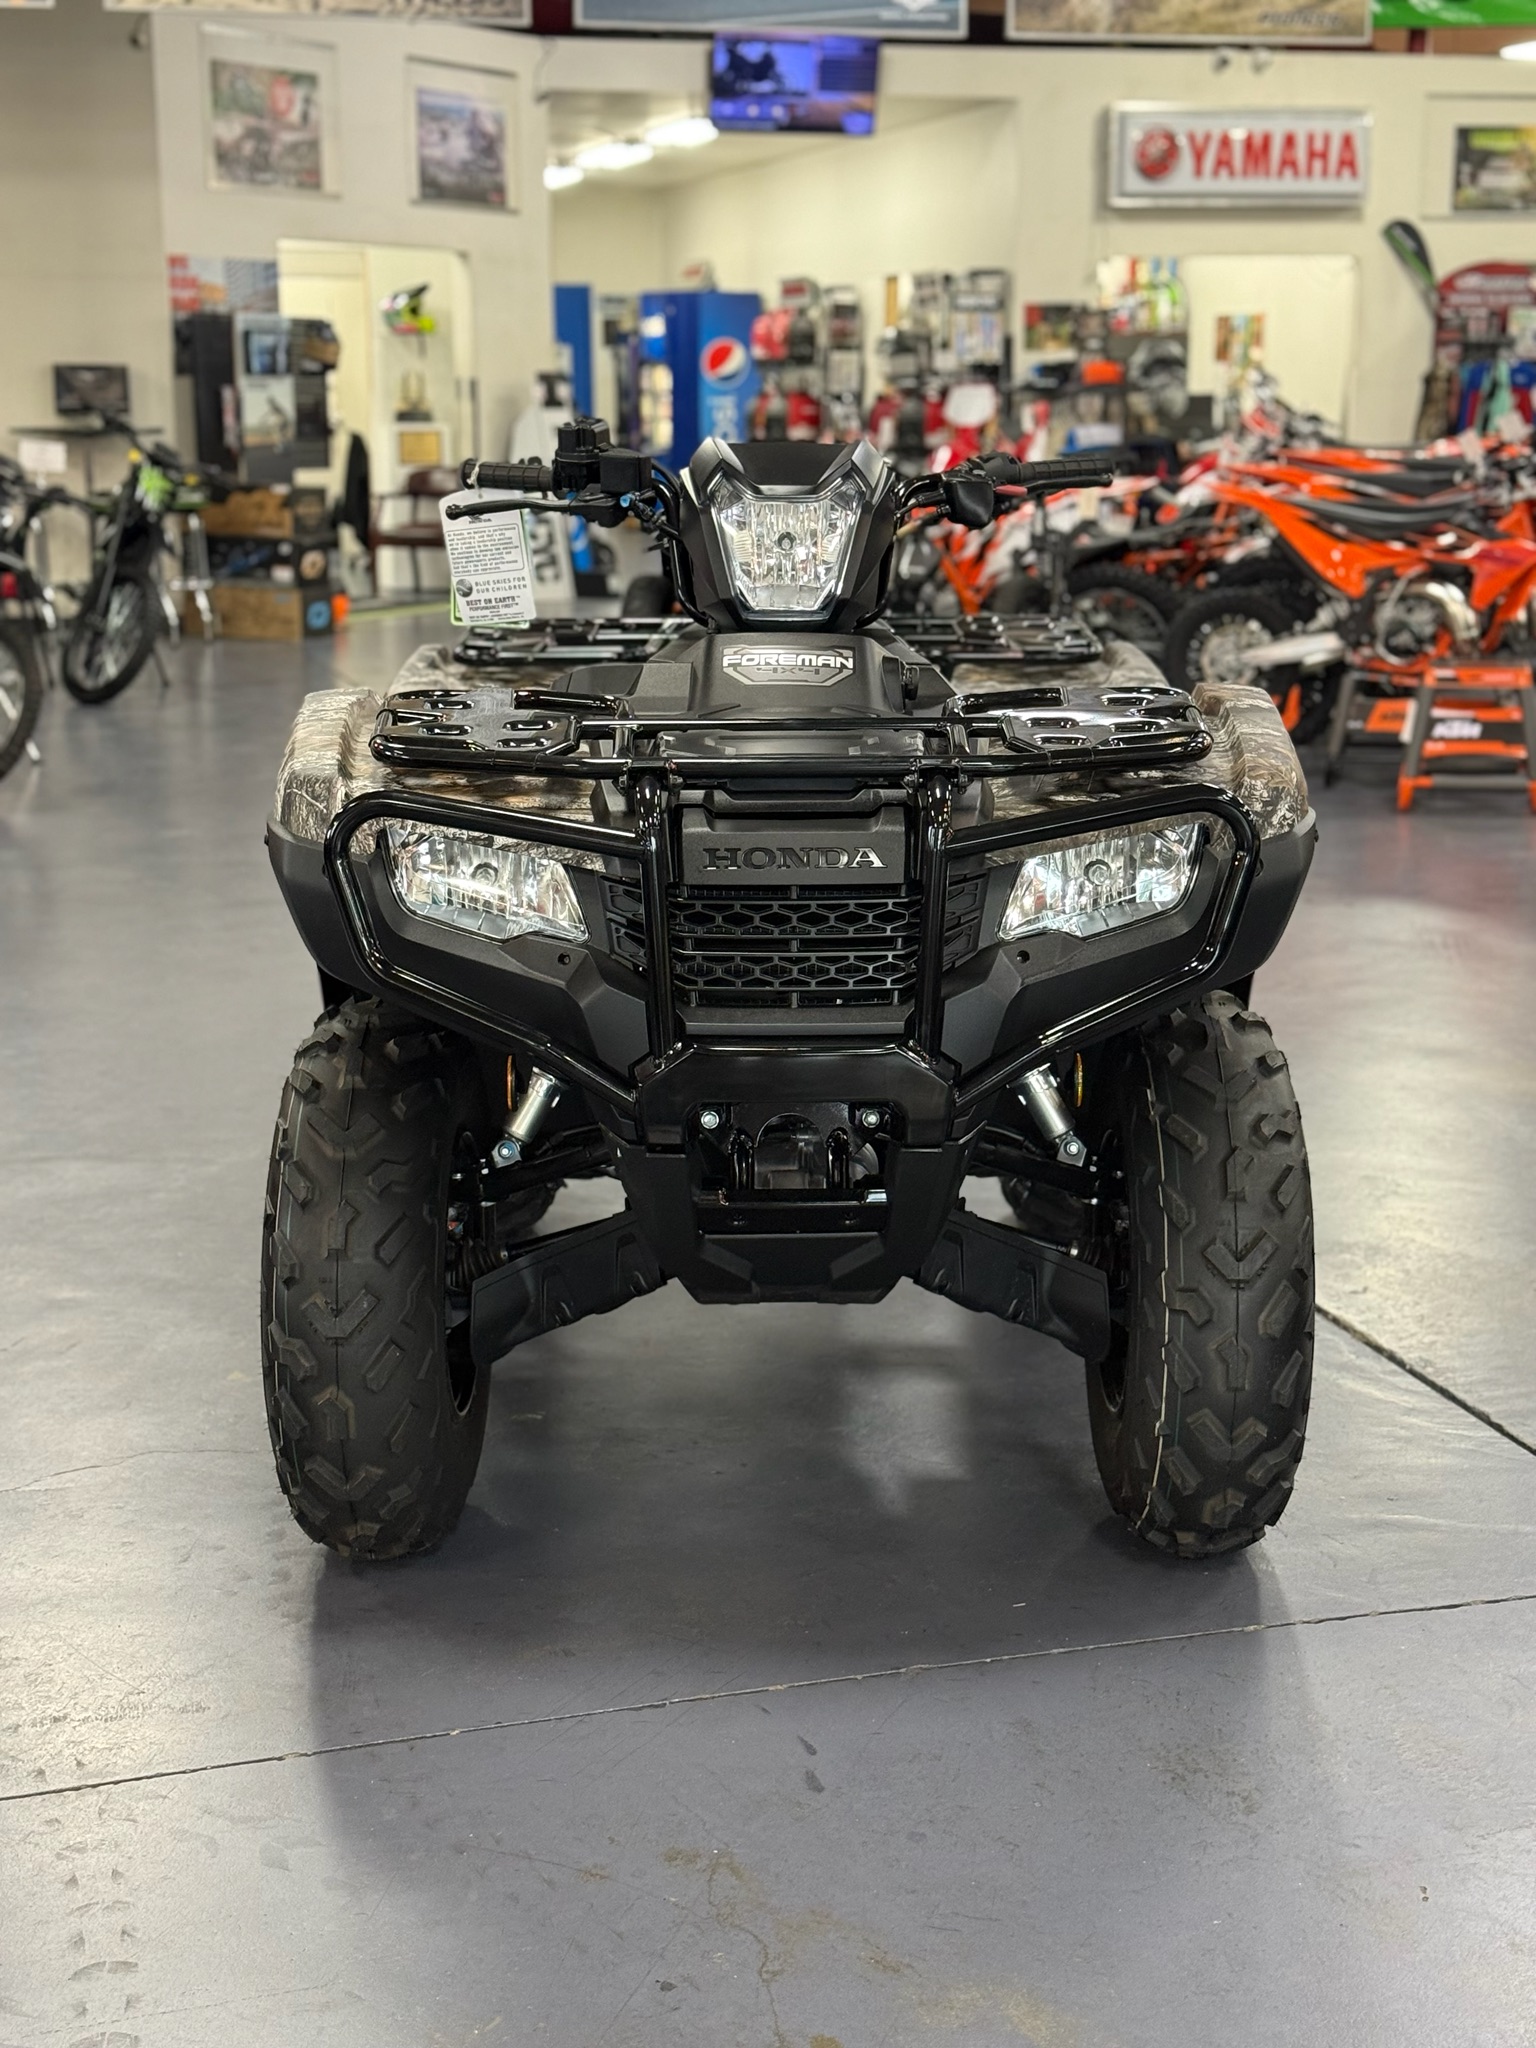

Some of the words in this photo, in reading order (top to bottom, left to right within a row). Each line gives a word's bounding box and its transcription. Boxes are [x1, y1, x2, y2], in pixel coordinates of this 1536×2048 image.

[1186, 129, 1359, 181] YAMAHA
[492, 584, 527, 592] CHILDREN
[466, 599, 482, 607] BEST
[722, 653, 854, 669] FOREMAN
[1432, 718, 1483, 740] KTM
[703, 847, 887, 869] HONDA
